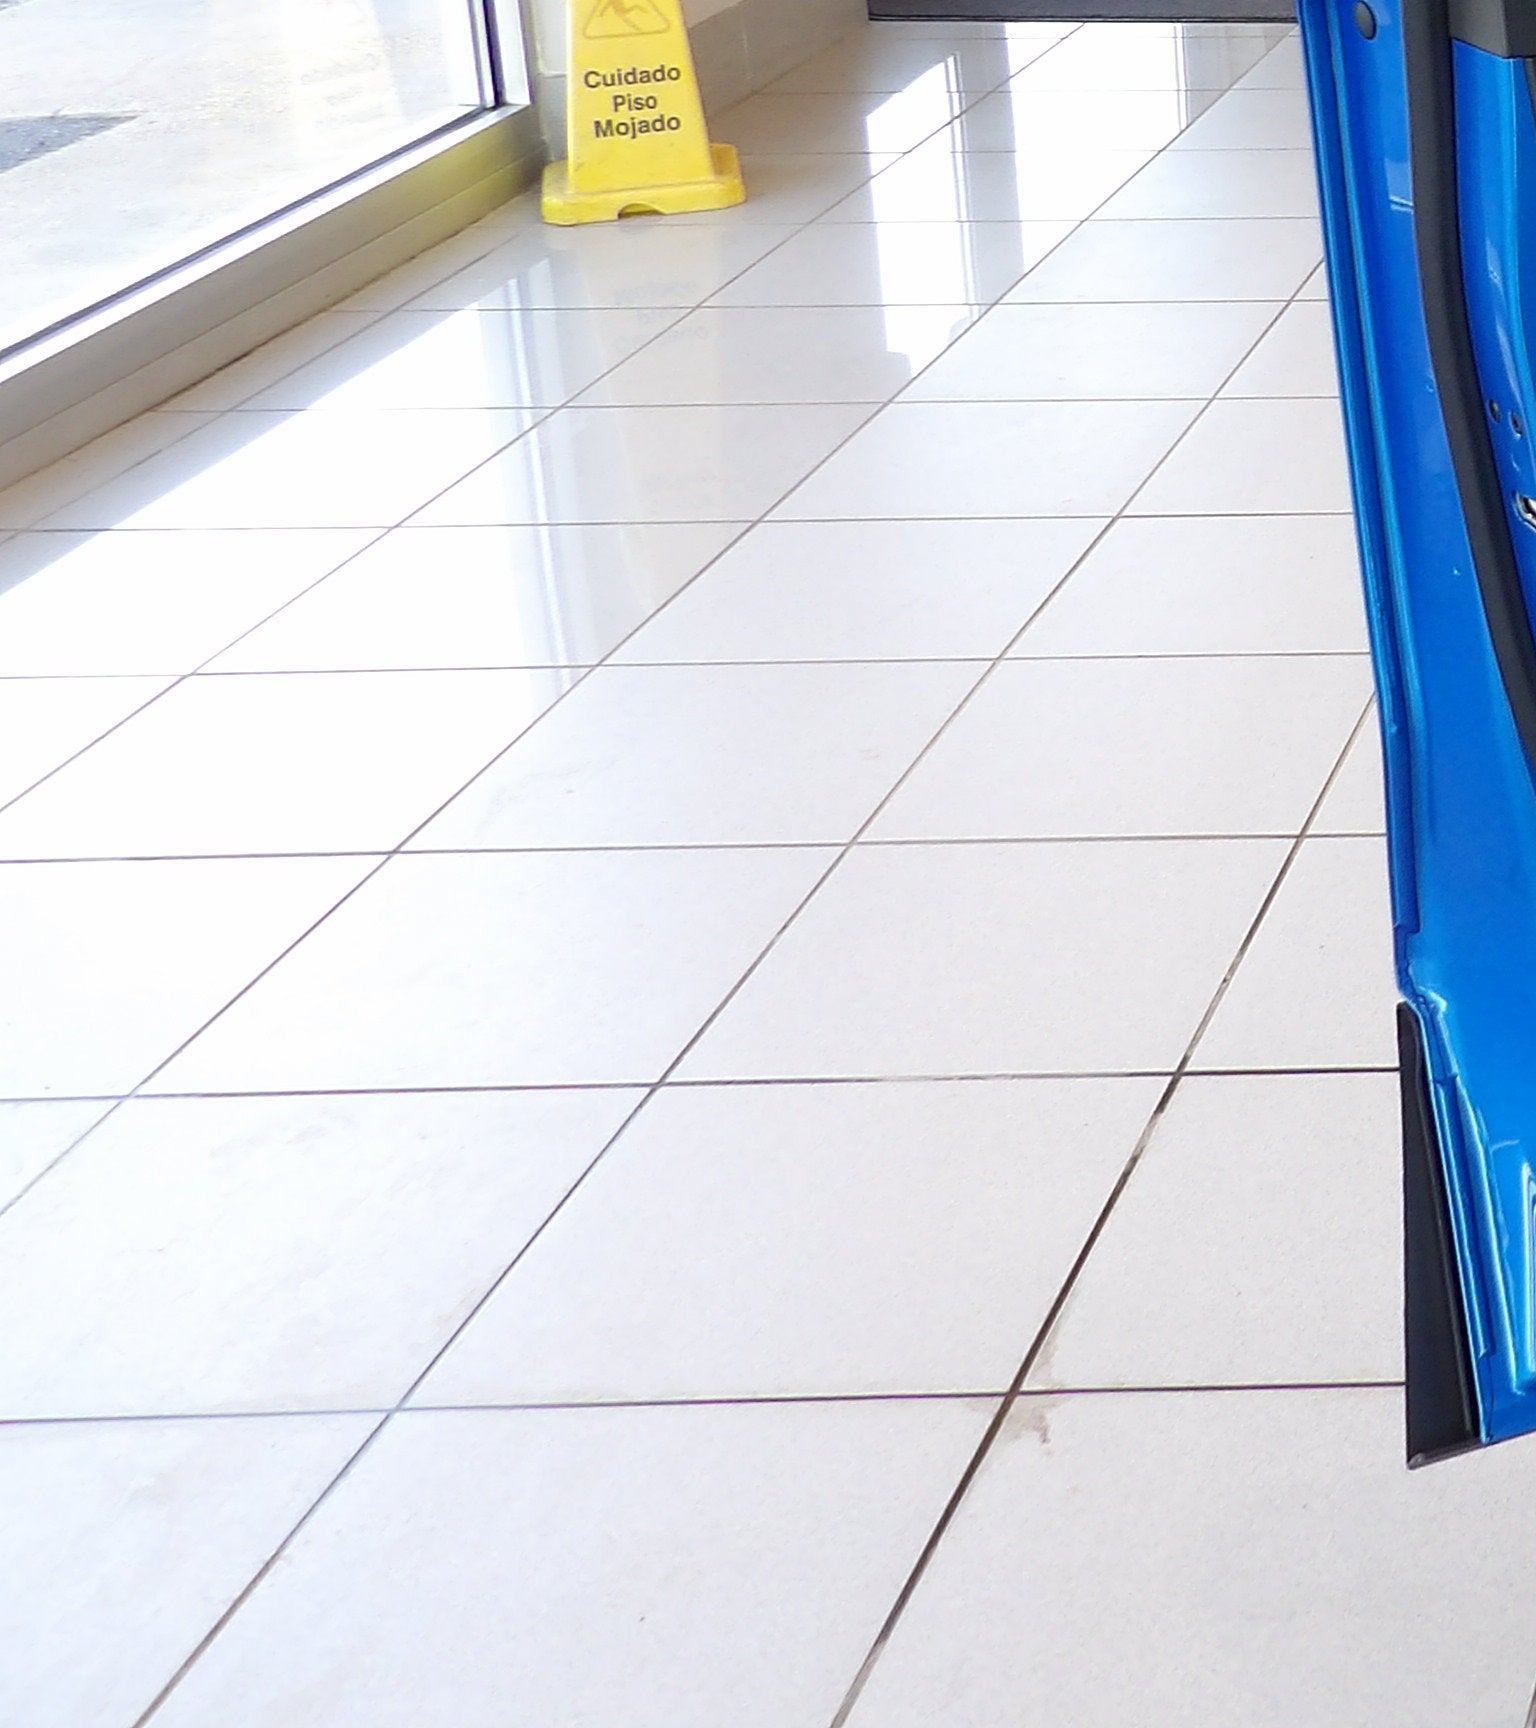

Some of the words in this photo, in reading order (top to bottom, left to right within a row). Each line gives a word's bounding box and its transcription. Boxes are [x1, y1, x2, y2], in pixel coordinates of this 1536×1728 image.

[583, 64, 681, 89] Cuidado
[612, 92, 658, 113] Piso
[593, 113, 681, 140] Mojado
